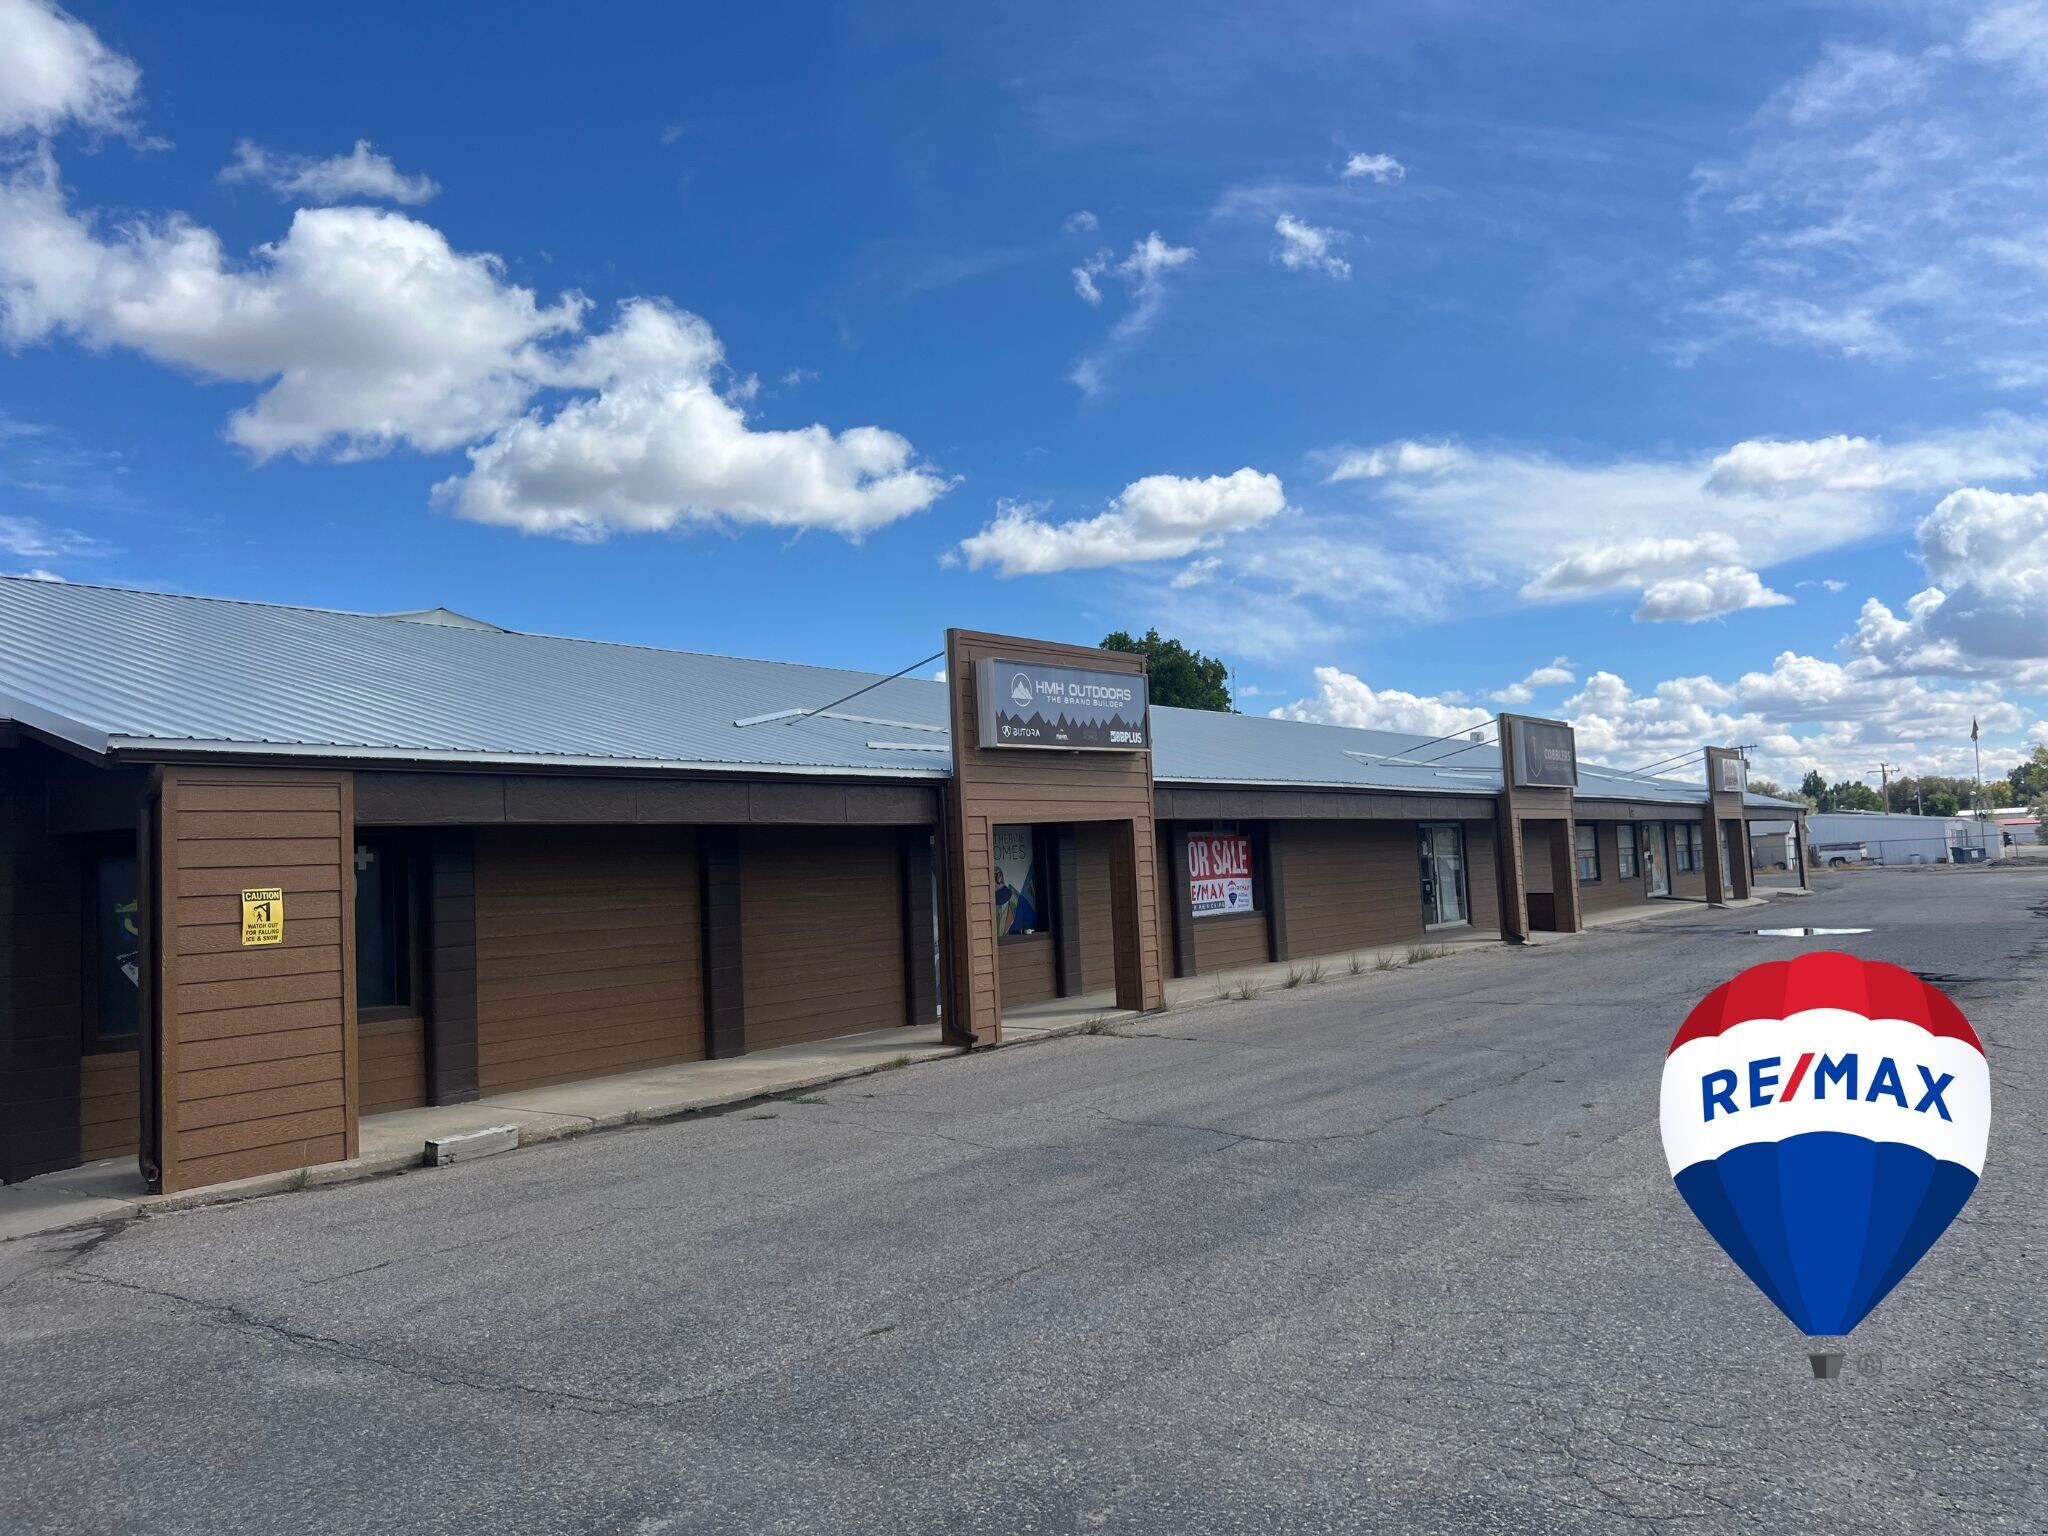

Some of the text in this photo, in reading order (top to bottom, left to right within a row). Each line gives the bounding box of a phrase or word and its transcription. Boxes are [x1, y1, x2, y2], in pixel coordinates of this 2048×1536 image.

[1036, 681, 1132, 701] HMH OUTDOORS
[1046, 695, 1124, 708] THE BRAND BUILDER
[1188, 840, 1248, 877] OR SALE
[245, 892, 279, 900] CAUTION
